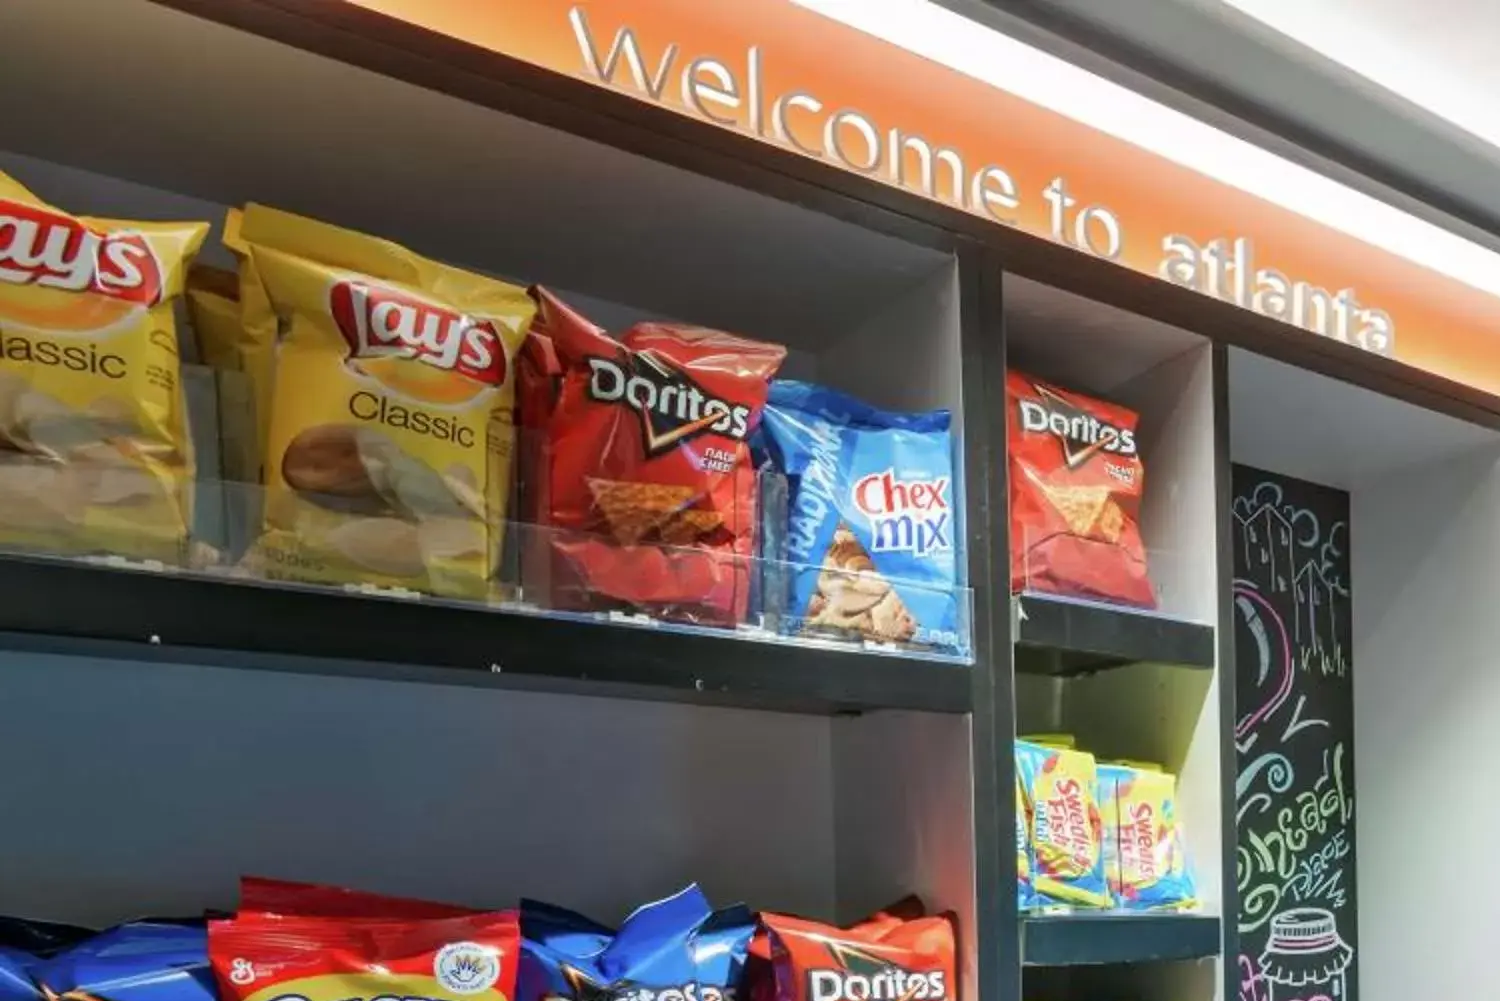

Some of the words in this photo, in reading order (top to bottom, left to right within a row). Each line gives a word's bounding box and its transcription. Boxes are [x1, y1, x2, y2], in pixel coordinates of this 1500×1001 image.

[569, 6, 1019, 226] welcome
[1043, 176, 1124, 260] to
[1160, 233, 1396, 357] atlanta
[0, 212, 144, 291] ay's
[0, 329, 127, 379] lassic
[346, 283, 496, 376] Lay's
[350, 391, 475, 449] Classic
[588, 357, 750, 438] Doritos
[1019, 399, 1136, 455] Doritos
[855, 473, 948, 516] Chex
[873, 512, 949, 555] mix
